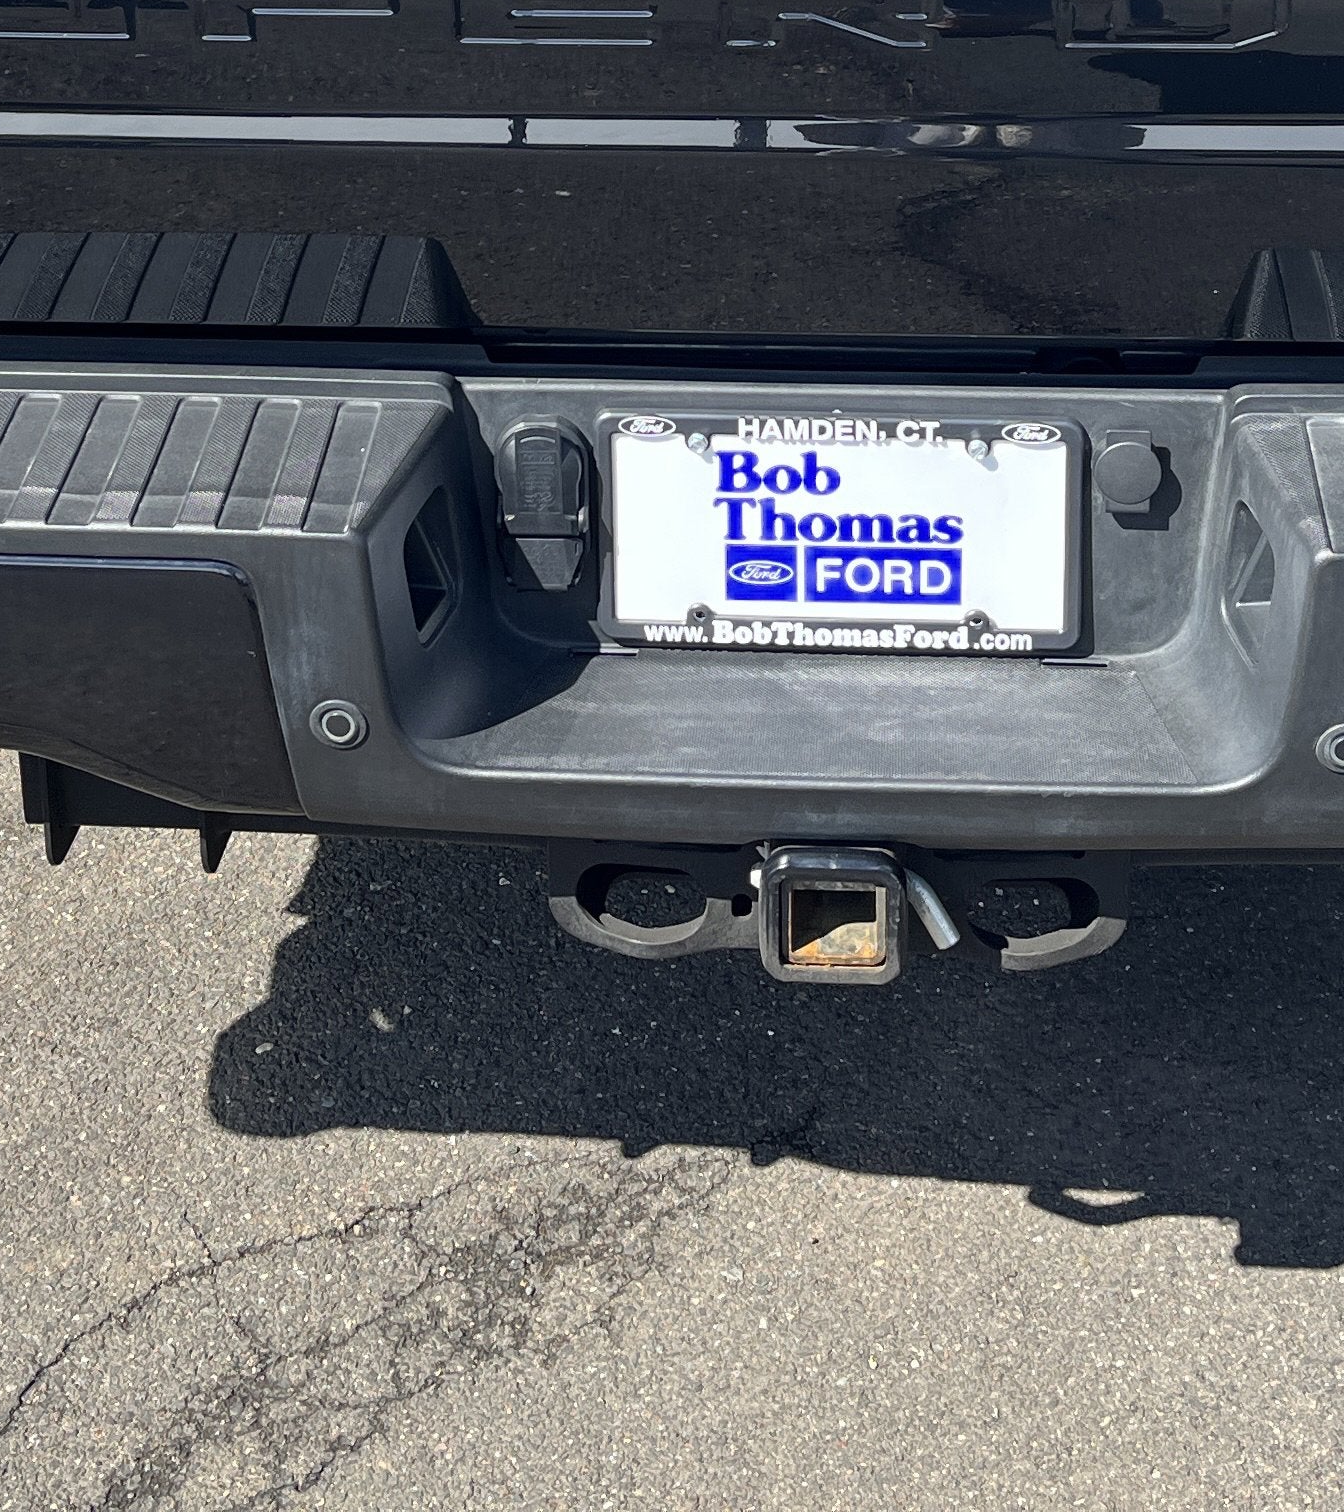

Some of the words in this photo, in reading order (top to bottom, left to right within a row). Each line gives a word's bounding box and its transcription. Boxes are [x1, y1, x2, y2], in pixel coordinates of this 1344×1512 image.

[629, 418, 665, 434] Ford
[737, 417, 887, 442] HAMDEN,
[896, 420, 943, 443] CT.
[1013, 425, 1049, 441] Ford
[715, 450, 841, 495] Bob
[712, 497, 964, 544] Thomas
[741, 564, 782, 580] Ford
[815, 557, 952, 595] FORD
[644, 619, 1033, 651] www.BobThomasFord.com
